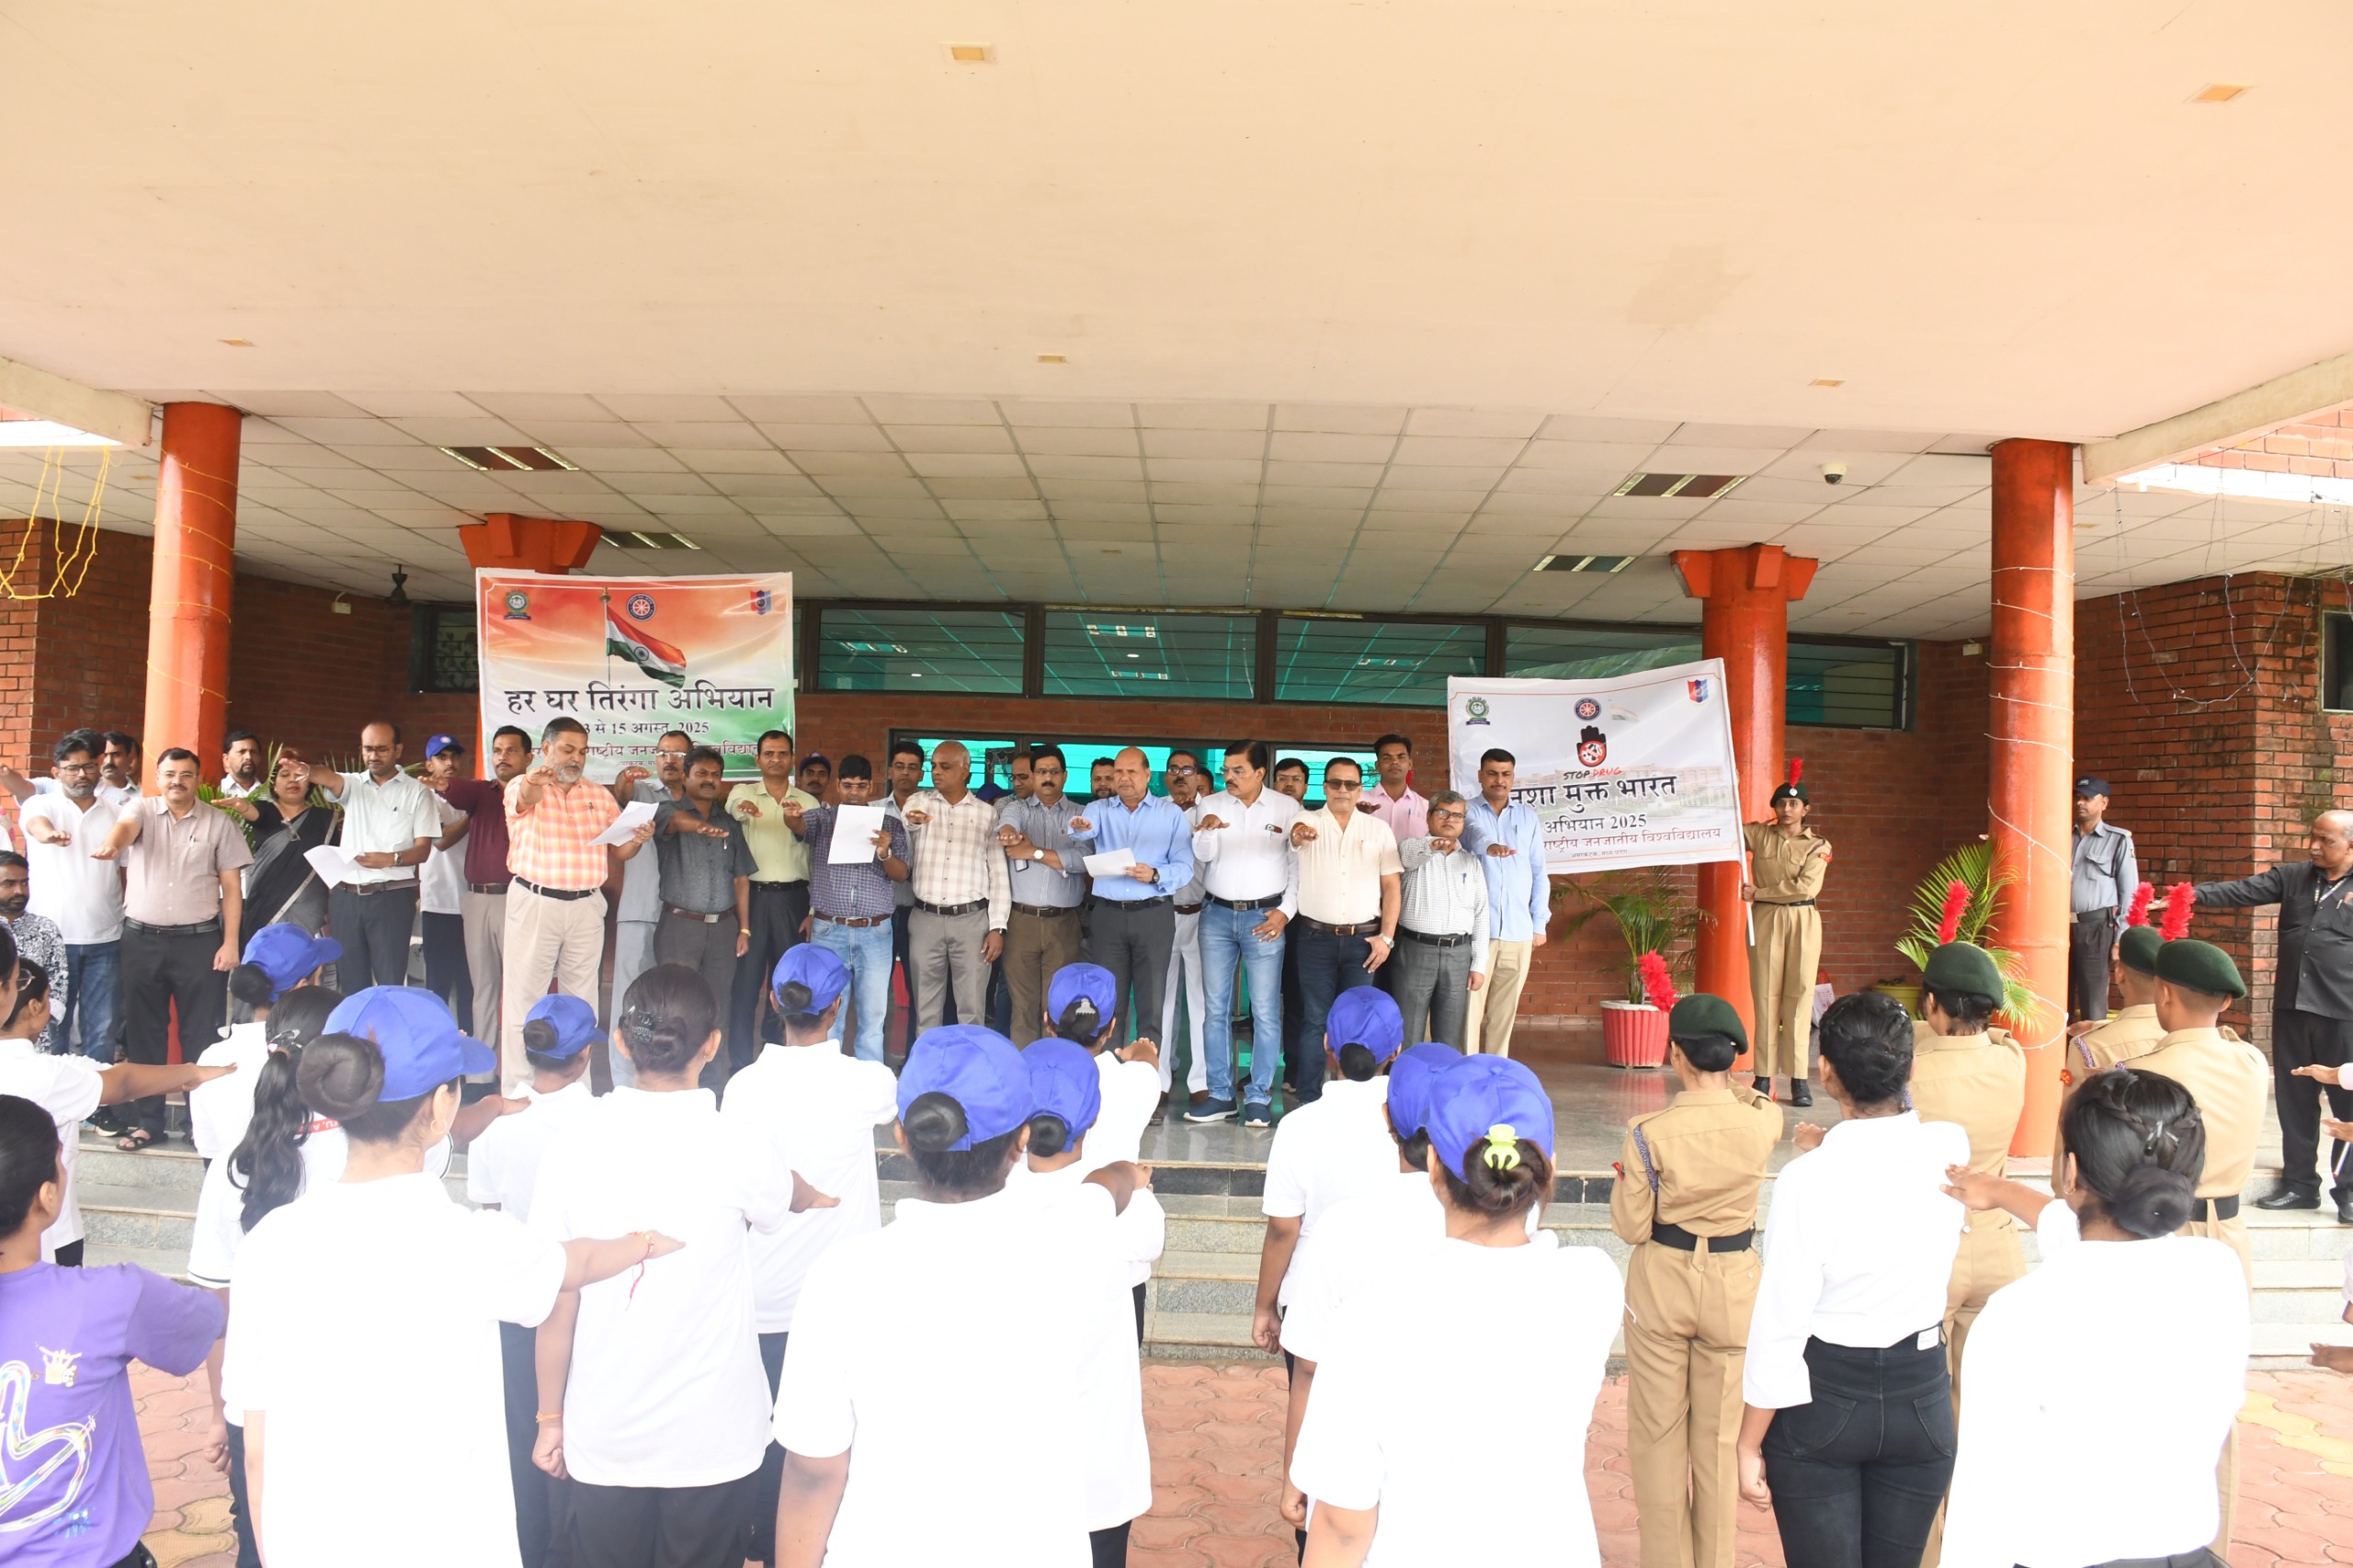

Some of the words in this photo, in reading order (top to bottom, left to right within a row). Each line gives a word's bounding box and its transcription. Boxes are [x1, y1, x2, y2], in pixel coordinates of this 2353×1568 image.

[505, 690, 537, 715] हर
[543, 691, 579, 711] घर
[585, 680, 659, 712] तिरंगा
[668, 679, 775, 710] अभियान
[595, 719, 607, 733] से
[612, 723, 626, 734] 15
[678, 722, 710, 733] 2025
[1563, 770, 1590, 780] STOP
[1593, 767, 1622, 777] DRUG
[1510, 786, 1557, 808] नशा
[1563, 781, 1609, 813] मुक्त
[1617, 776, 1677, 798] भारत
[1544, 815, 1604, 834] अभियान
[1610, 814, 1646, 829] 2025
[1544, 836, 1578, 853] राष्ट्रीय
[1581, 832, 1638, 846] जनजातीय
[1642, 827, 1721, 843] विश्वविद्यालय
